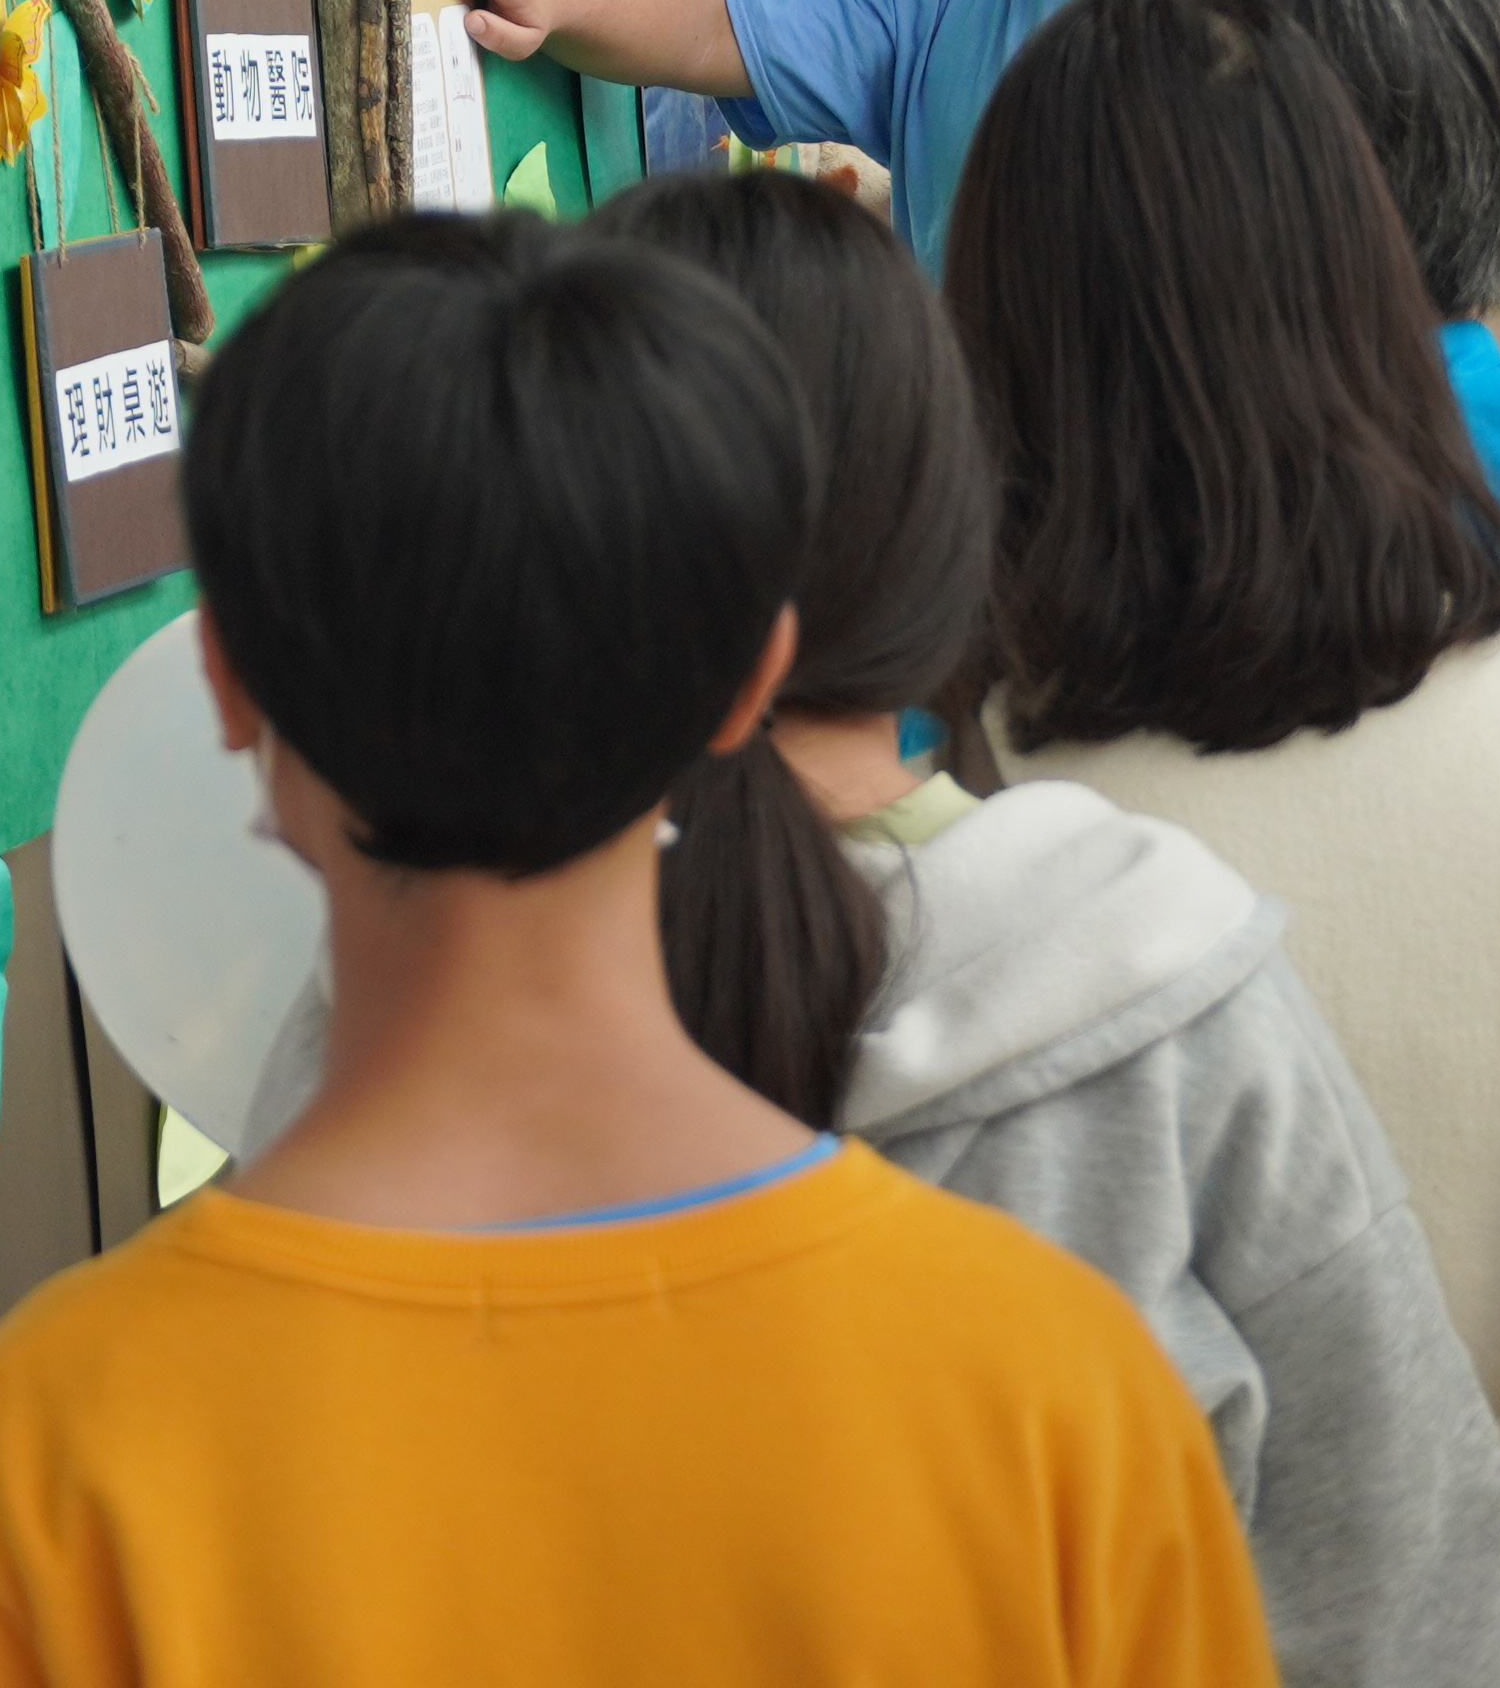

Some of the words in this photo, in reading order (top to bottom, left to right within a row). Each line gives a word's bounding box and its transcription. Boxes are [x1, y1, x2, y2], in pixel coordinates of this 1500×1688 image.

[212, 49, 312, 123] 動物醫院
[64, 358, 172, 457] 理財桌遊
